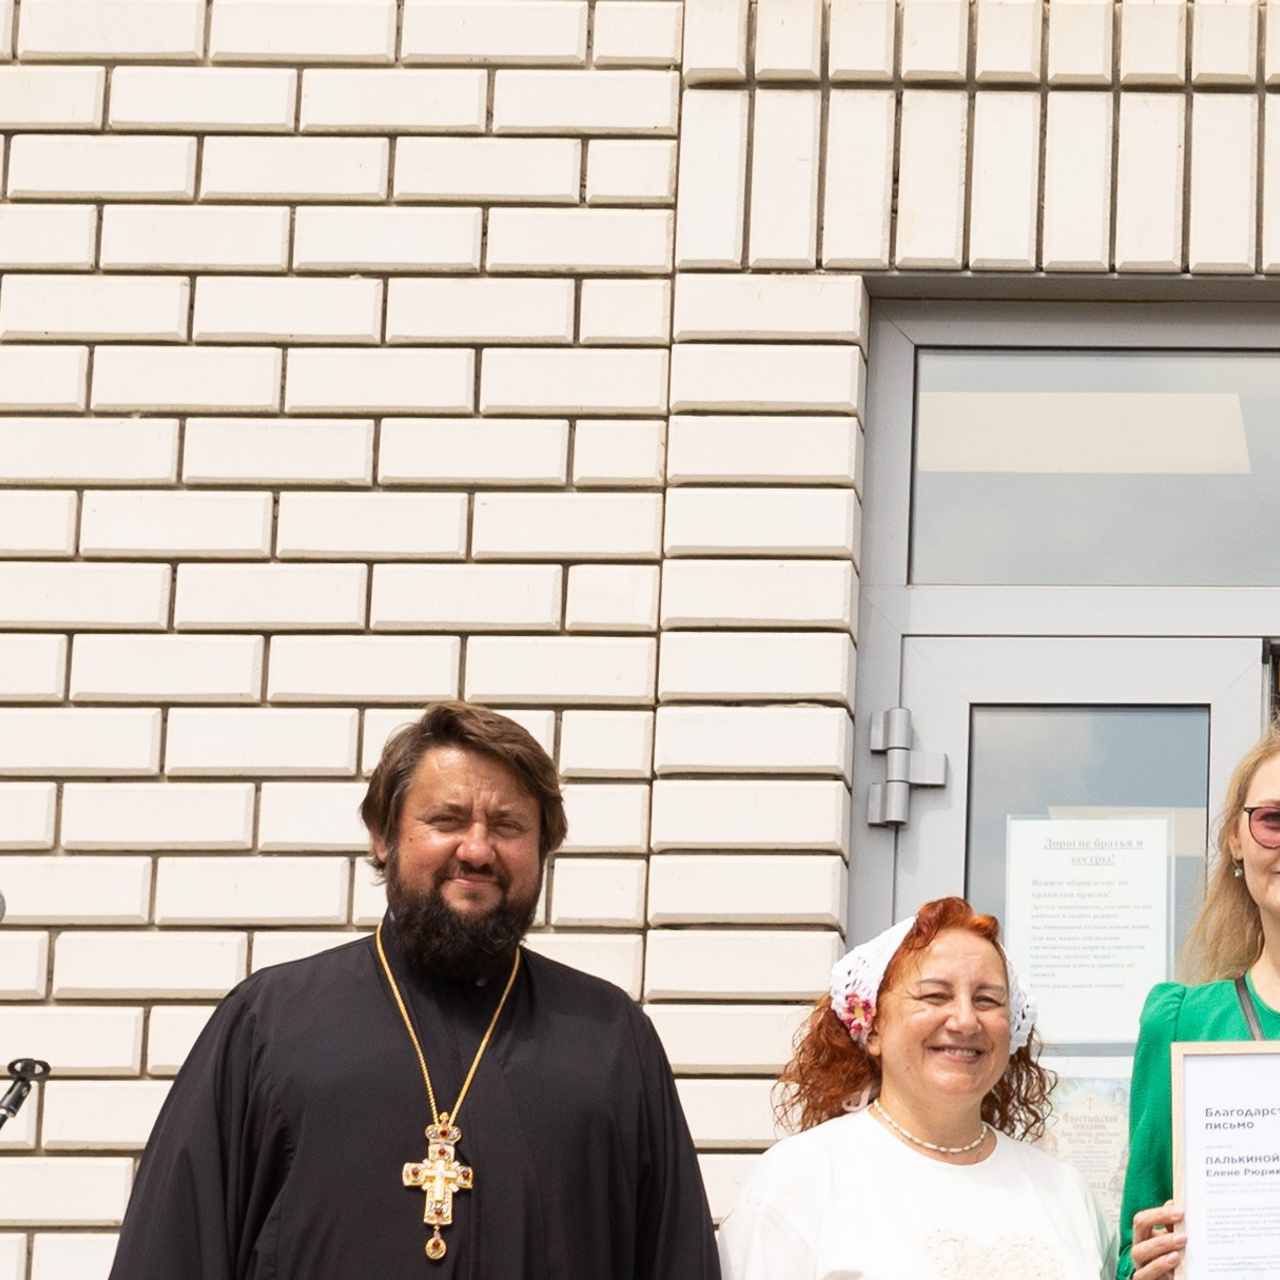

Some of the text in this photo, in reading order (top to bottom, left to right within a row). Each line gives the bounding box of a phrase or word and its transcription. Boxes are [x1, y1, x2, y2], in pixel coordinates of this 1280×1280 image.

[1205, 1121, 1255, 1130] письмо
[1205, 1152, 1280, 1165] ПАЛЬКИНОЙ
[1205, 1168, 1241, 1178] Елене
